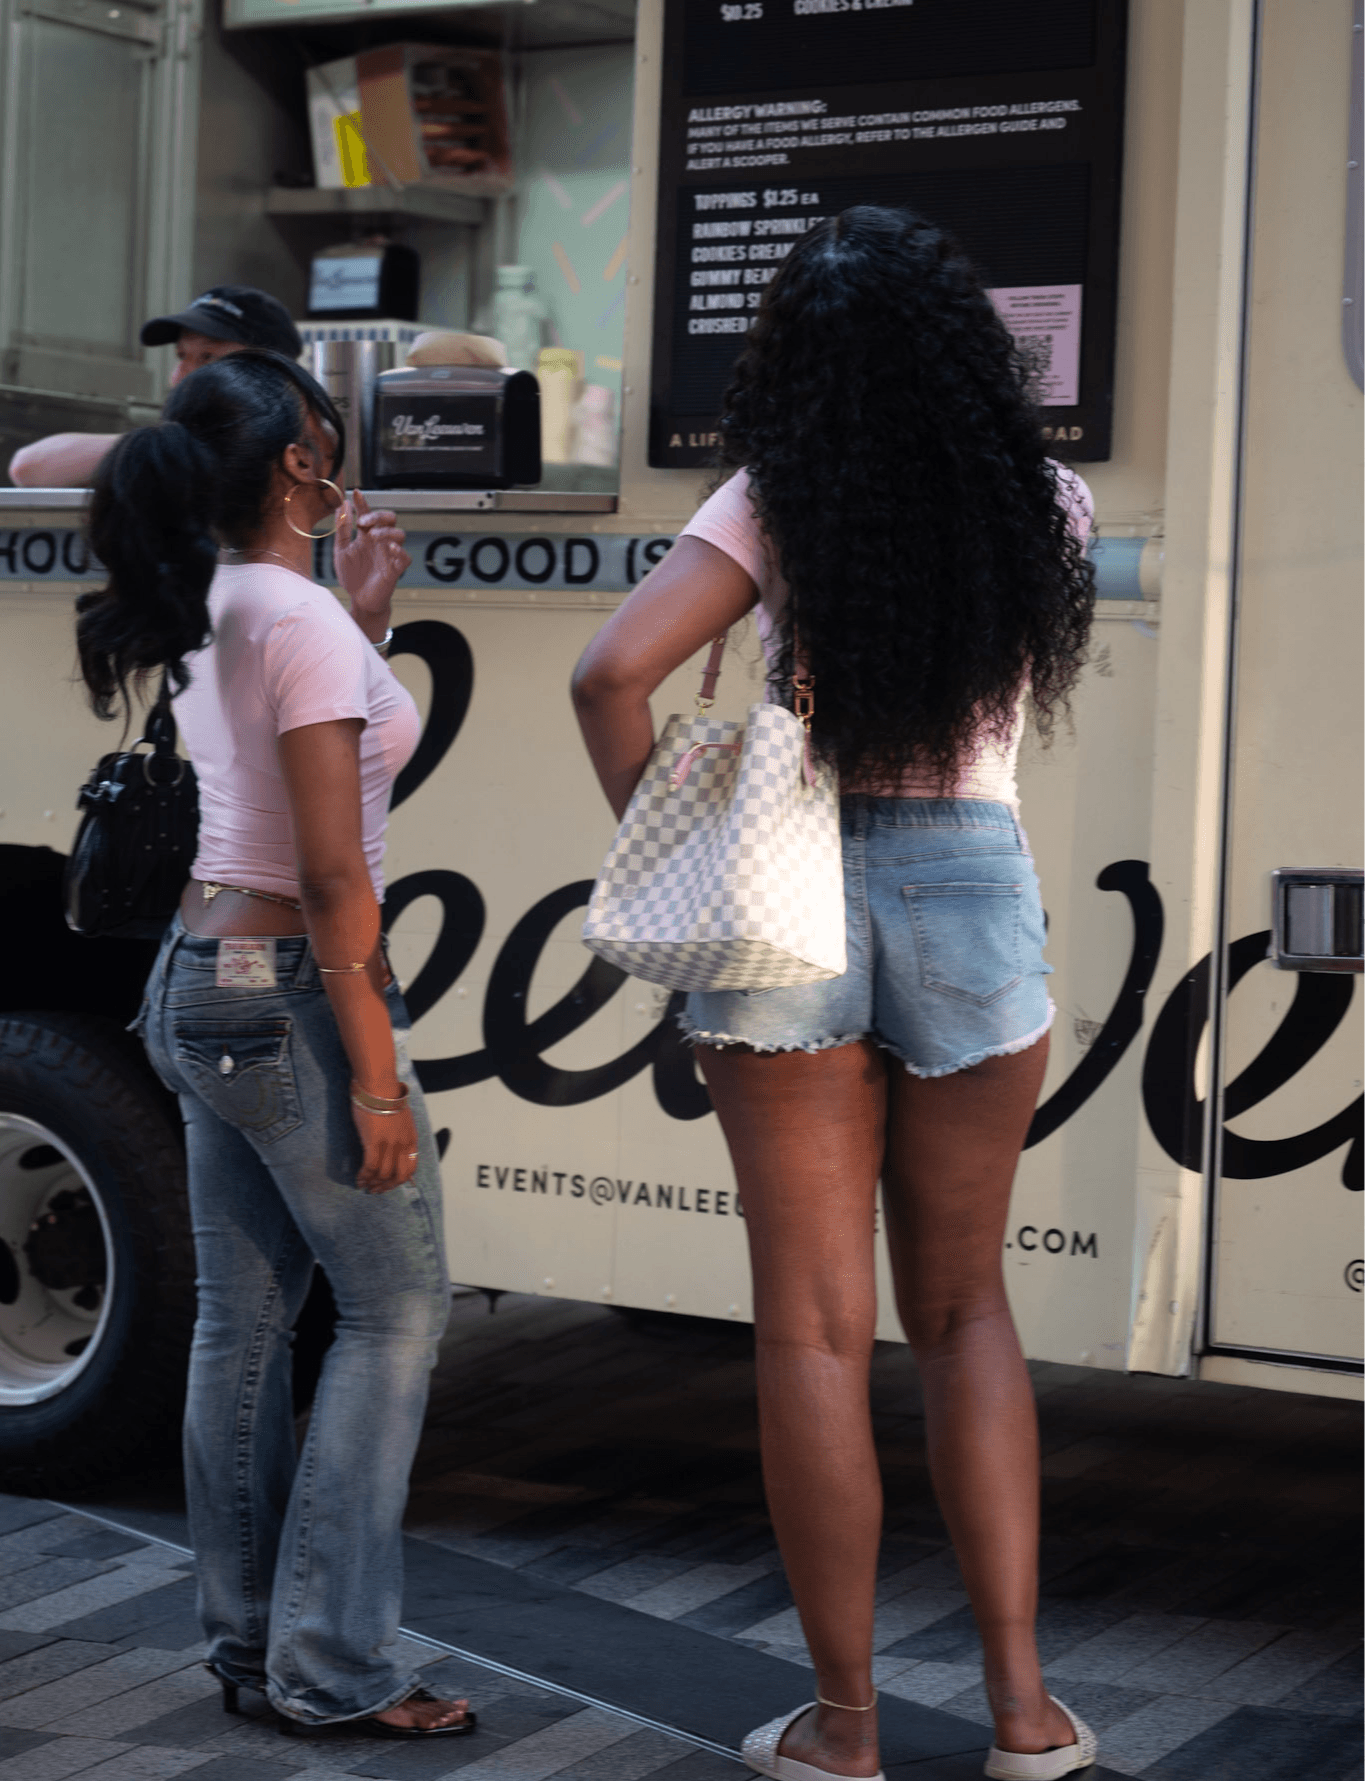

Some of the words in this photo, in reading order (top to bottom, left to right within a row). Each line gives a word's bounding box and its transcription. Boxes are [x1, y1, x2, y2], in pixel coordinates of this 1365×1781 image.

[687, 126, 722, 139] MANY
[723, 125, 741, 137] OF
[742, 124, 763, 135] THE
[764, 122, 799, 133] ITEMS
[801, 119, 820, 130] WE
[821, 117, 856, 129] SERVE
[858, 113, 911, 126] CONTAIN
[913, 108, 971, 122] COMMON
[972, 105, 1009, 118] FOOD
[1010, 100, 1083, 116] ALLERGENS.
[688, 105, 754, 122] ALLERGY
[755, 101, 828, 117] WARNING:
[687, 144, 700, 154] IF
[701, 143, 725, 154] YOU
[726, 140, 755, 152] HAVE
[756, 139, 765, 150] A
[766, 137, 800, 149] FOOD
[801, 133, 854, 147] ALLERGY,
[855, 130, 892, 144] REFER
[894, 129, 911, 140] TO
[912, 127, 935, 139] THE
[936, 123, 998, 137] ALLERGEN
[999, 120, 1039, 133] GUIDE
[1040, 118, 1067, 130] AND
[686, 158, 722, 171] ALERT
[723, 158, 732, 168] A
[733, 154, 791, 167] SCOOPER.
[695, 192, 758, 210] TOPPINGS
[763, 189, 798, 209] $1.25
[801, 193, 820, 205] EA
[693, 221, 752, 239] RAINBOW
[754, 217, 826, 236] SPRINKLE
[692, 246, 747, 263] COOKIES
[691, 270, 742, 287] GUMMY
[690, 293, 745, 311] ALMOND
[689, 317, 749, 335] CRUSHED
[670, 434, 683, 448] A
[690, 433, 723, 448] LIF
[424, 536, 600, 585] GOOD
